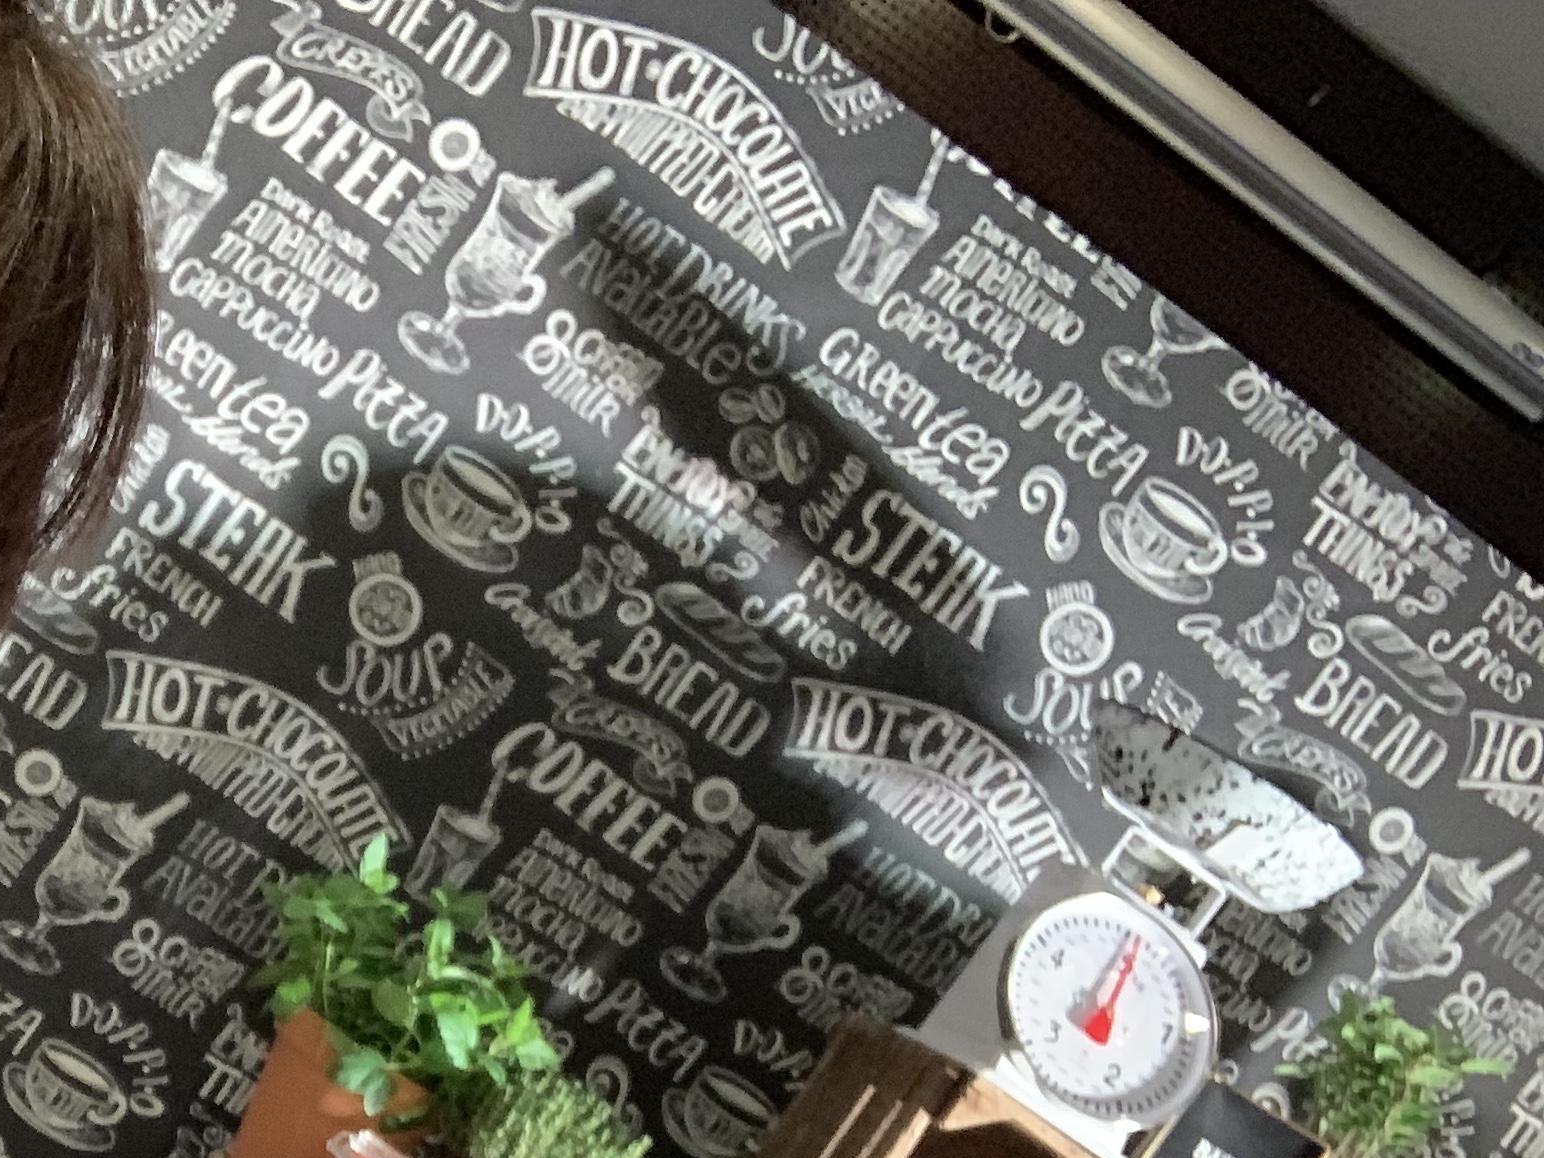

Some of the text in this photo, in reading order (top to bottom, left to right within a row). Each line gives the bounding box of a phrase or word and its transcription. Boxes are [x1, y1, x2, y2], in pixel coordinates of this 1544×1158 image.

[212, 55, 424, 225] COFFEE
[534, 18, 658, 98] HOT
[658, 52, 834, 250] CHOCOLATE
[597, 196, 686, 270] HOT
[657, 241, 804, 377] DRINKS
[139, 450, 334, 621] STEAK
[607, 459, 728, 566] THINGS
[1299, 496, 1419, 601] THINGS
[43, 564, 168, 642] fries
[103, 523, 222, 627] FRENCH
[789, 556, 911, 655] FRENCH
[833, 490, 1036, 649] STEAK
[740, 590, 857, 670] fries
[1420, 626, 1544, 703] fries
[112, 662, 226, 733] HOT
[606, 617, 769, 756] BREAD
[796, 691, 912, 761] HOT
[1294, 644, 1447, 788] BREAD
[491, 722, 686, 870] COFFEE
[175, 817, 264, 885] HOT
[853, 844, 938, 905] HOT
